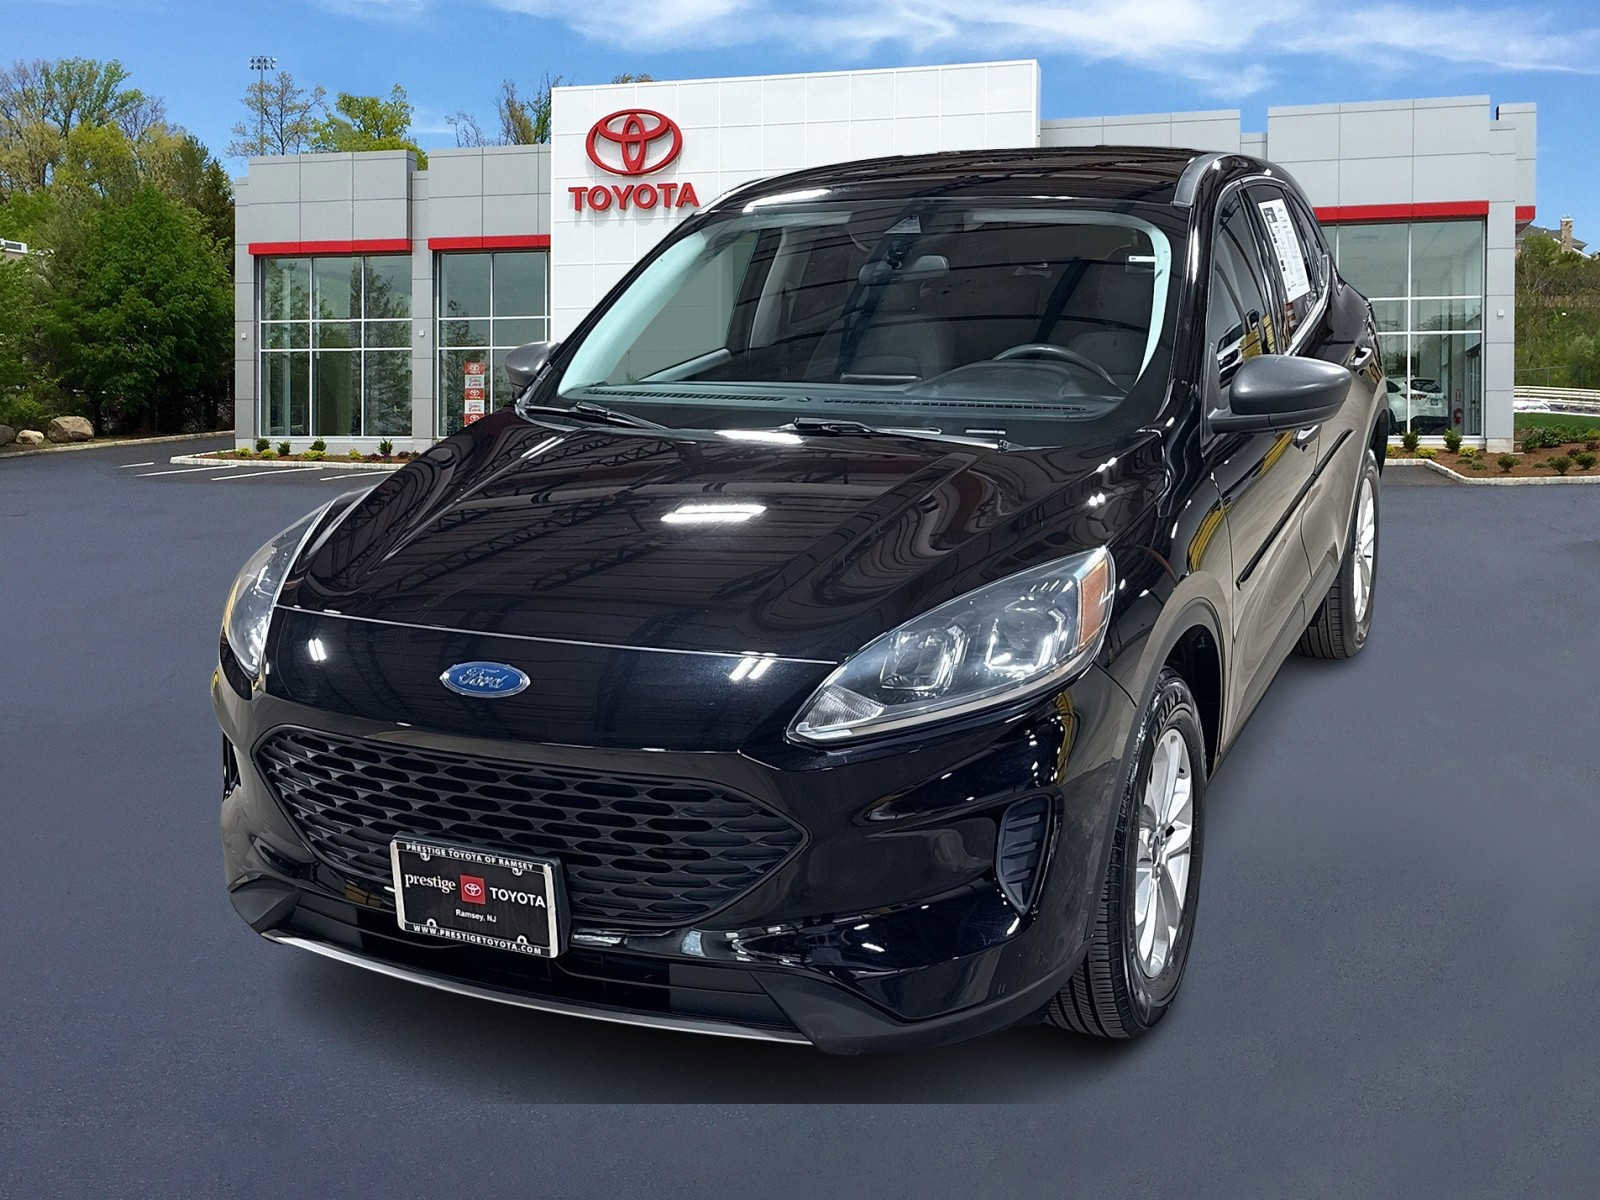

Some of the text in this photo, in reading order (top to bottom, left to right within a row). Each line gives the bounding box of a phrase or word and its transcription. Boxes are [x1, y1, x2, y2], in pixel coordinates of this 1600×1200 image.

[568, 182, 700, 212] TOYOTA
[459, 667, 509, 689] Ford
[406, 843, 534, 871] PRESTIGE TOYOTA OF RAMSEY
[404, 873, 546, 909] prestige TOYOTA
[455, 908, 497, 923] Ramsey, NJ
[413, 924, 542, 955] WWW.PRESTIGETOYOTA.COM
